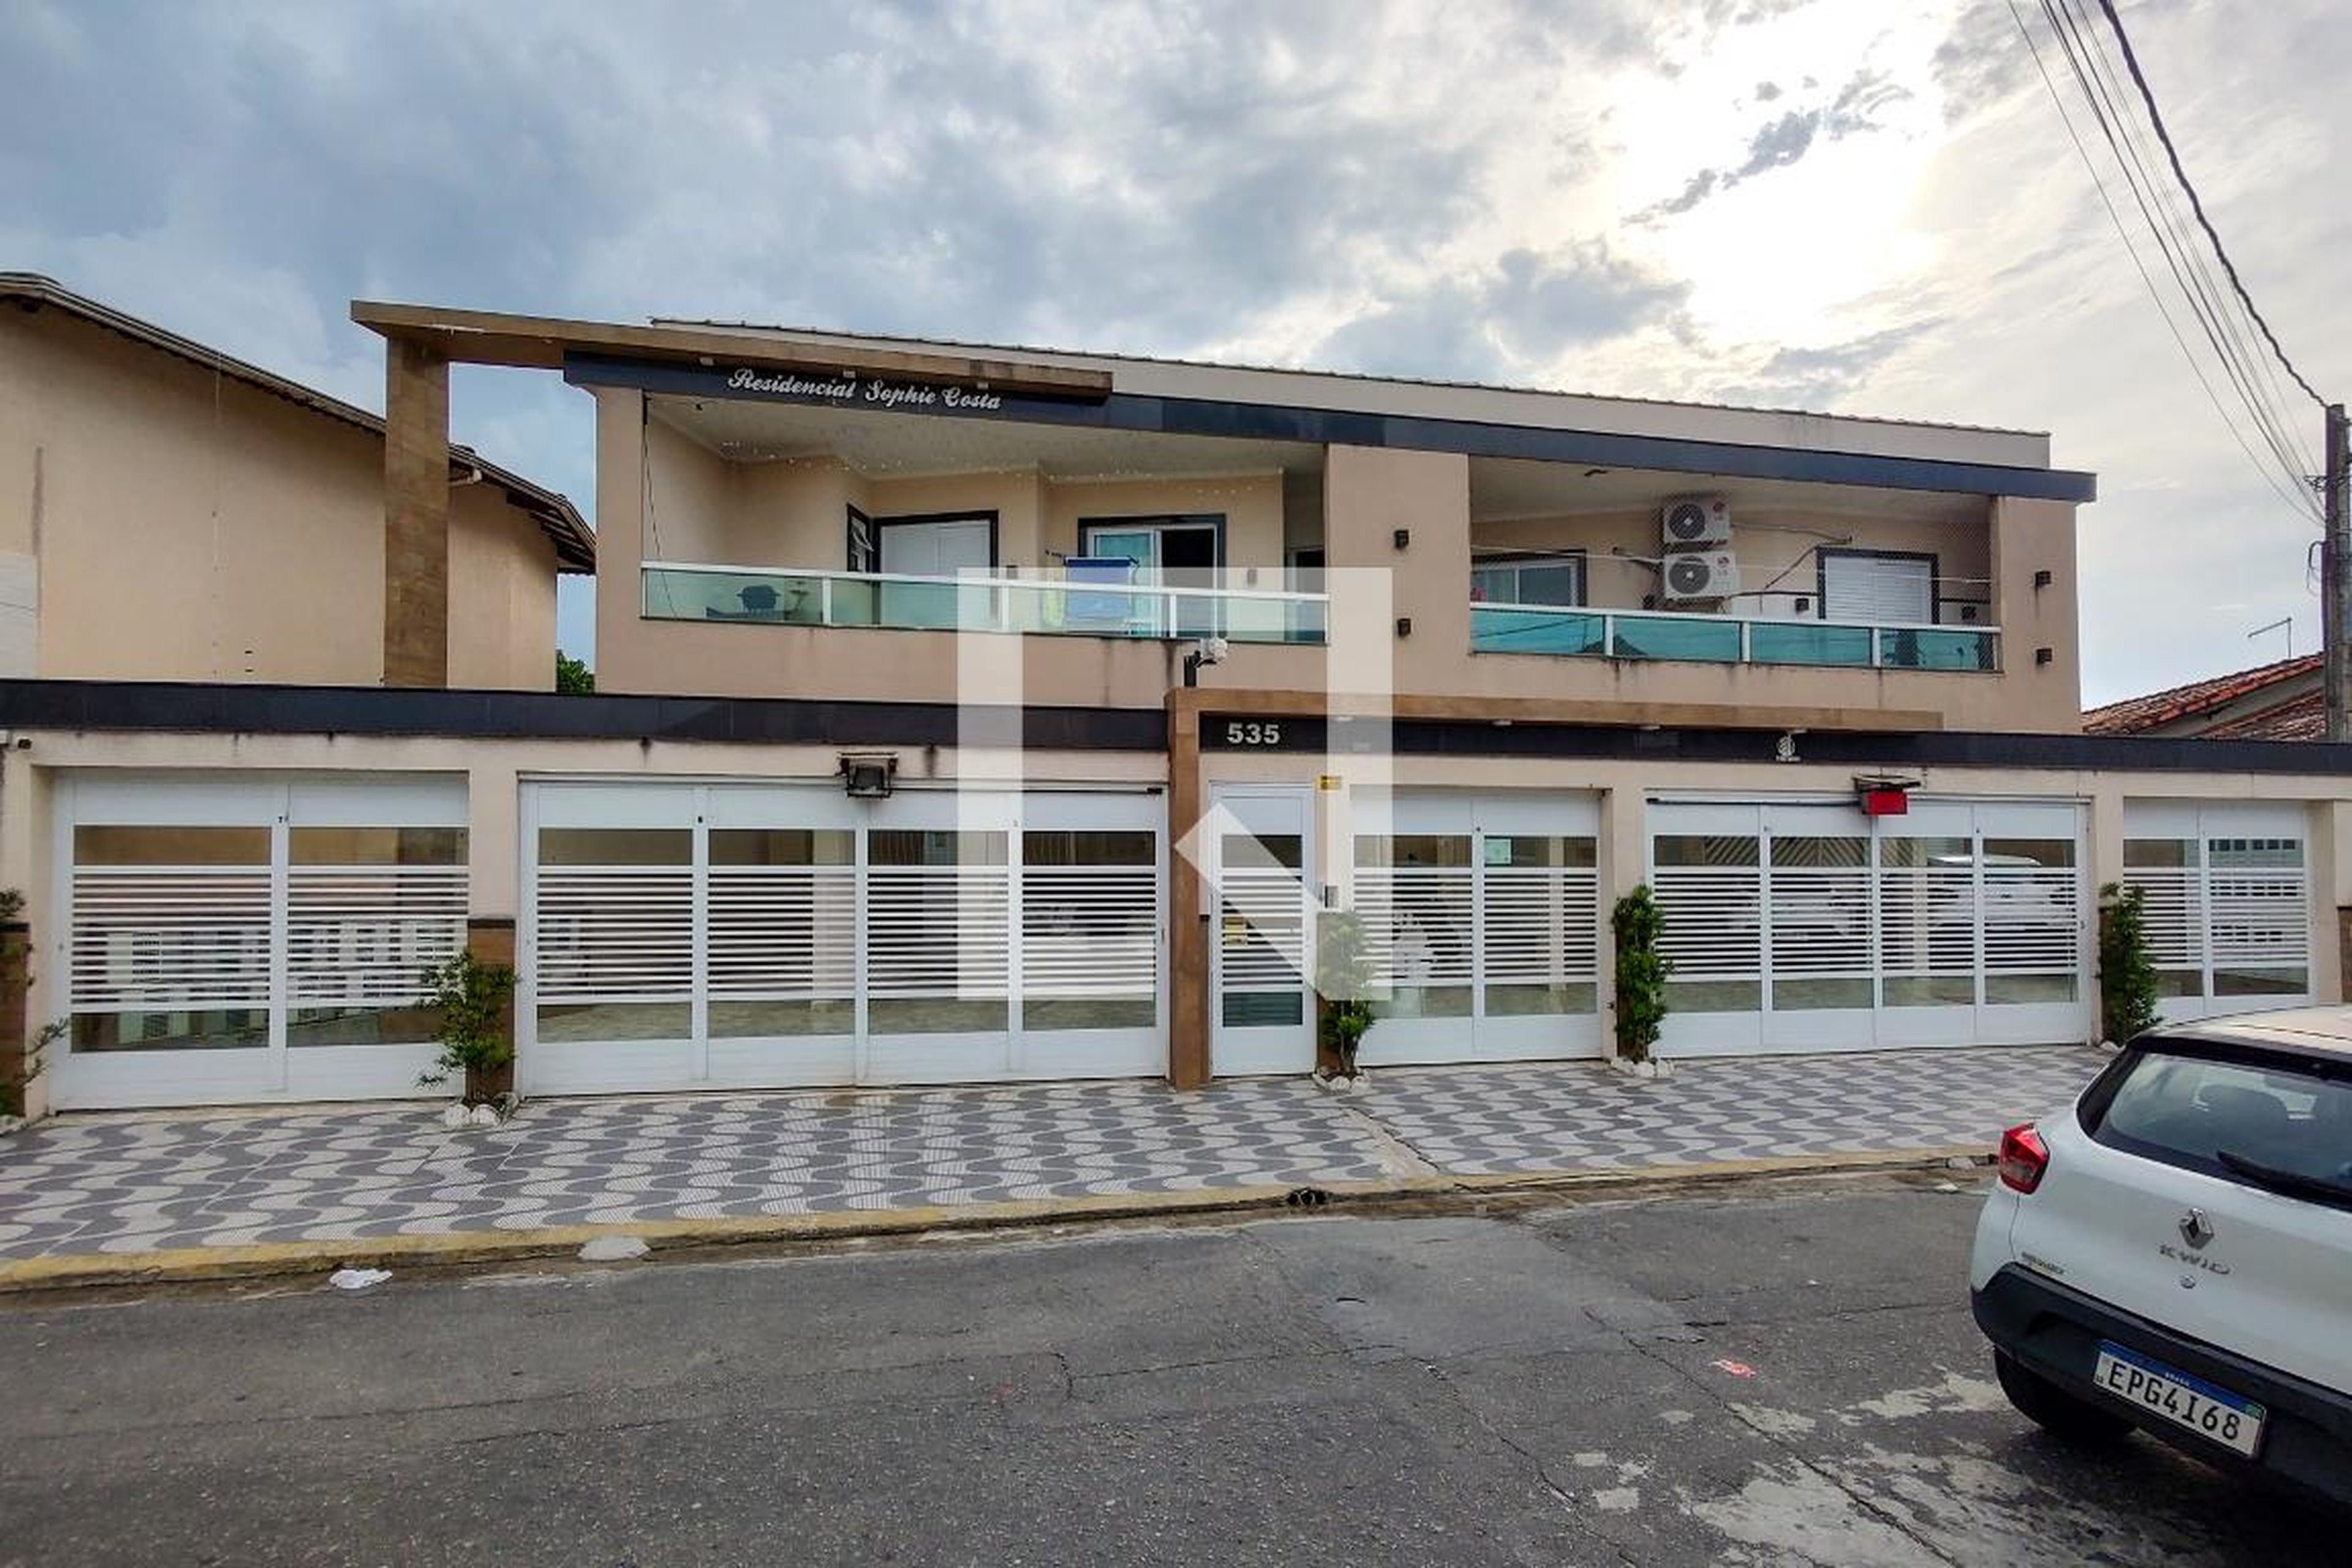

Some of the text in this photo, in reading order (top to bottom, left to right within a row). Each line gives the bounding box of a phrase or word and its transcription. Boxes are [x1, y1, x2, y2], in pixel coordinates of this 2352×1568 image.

[728, 368, 1002, 409] Residencial Sophie Costa
[1227, 722, 1280, 744] 535
[2108, 1362, 2241, 1440] EPG4I68
